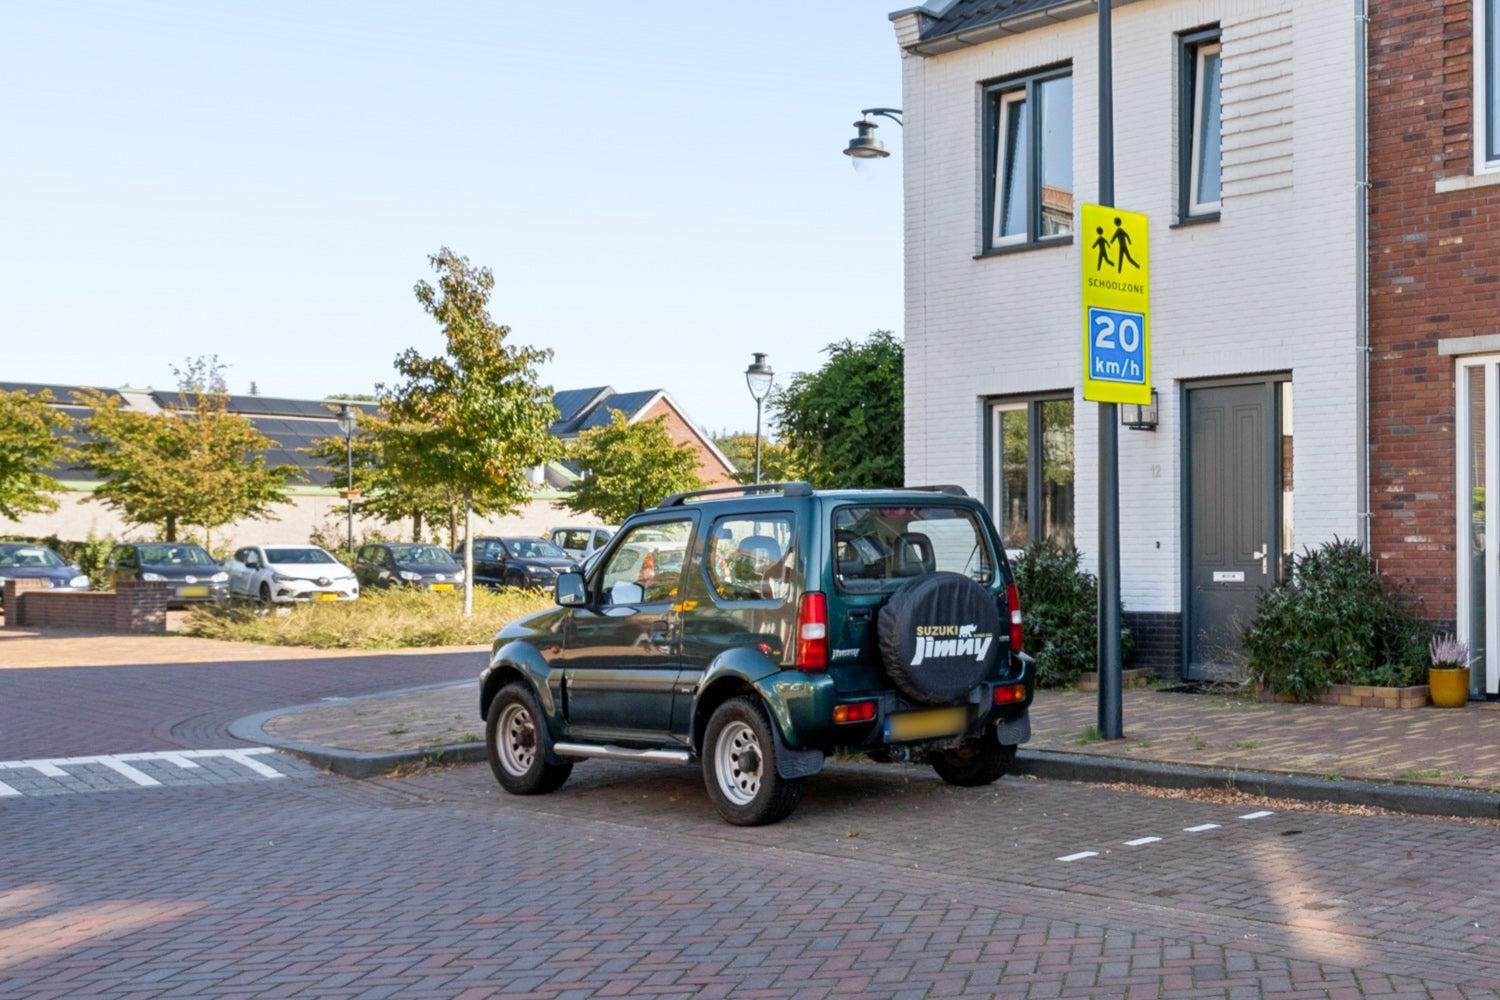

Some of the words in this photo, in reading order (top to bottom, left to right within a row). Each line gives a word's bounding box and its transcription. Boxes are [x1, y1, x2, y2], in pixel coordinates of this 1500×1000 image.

[1088, 277, 1144, 294] SCHOOLZONE
[1095, 315, 1139, 352] 20
[1095, 356, 1140, 377] km/h
[1150, 464, 1161, 478] 12
[916, 625, 958, 636] SUZUKI
[910, 636, 993, 666] Jimny
